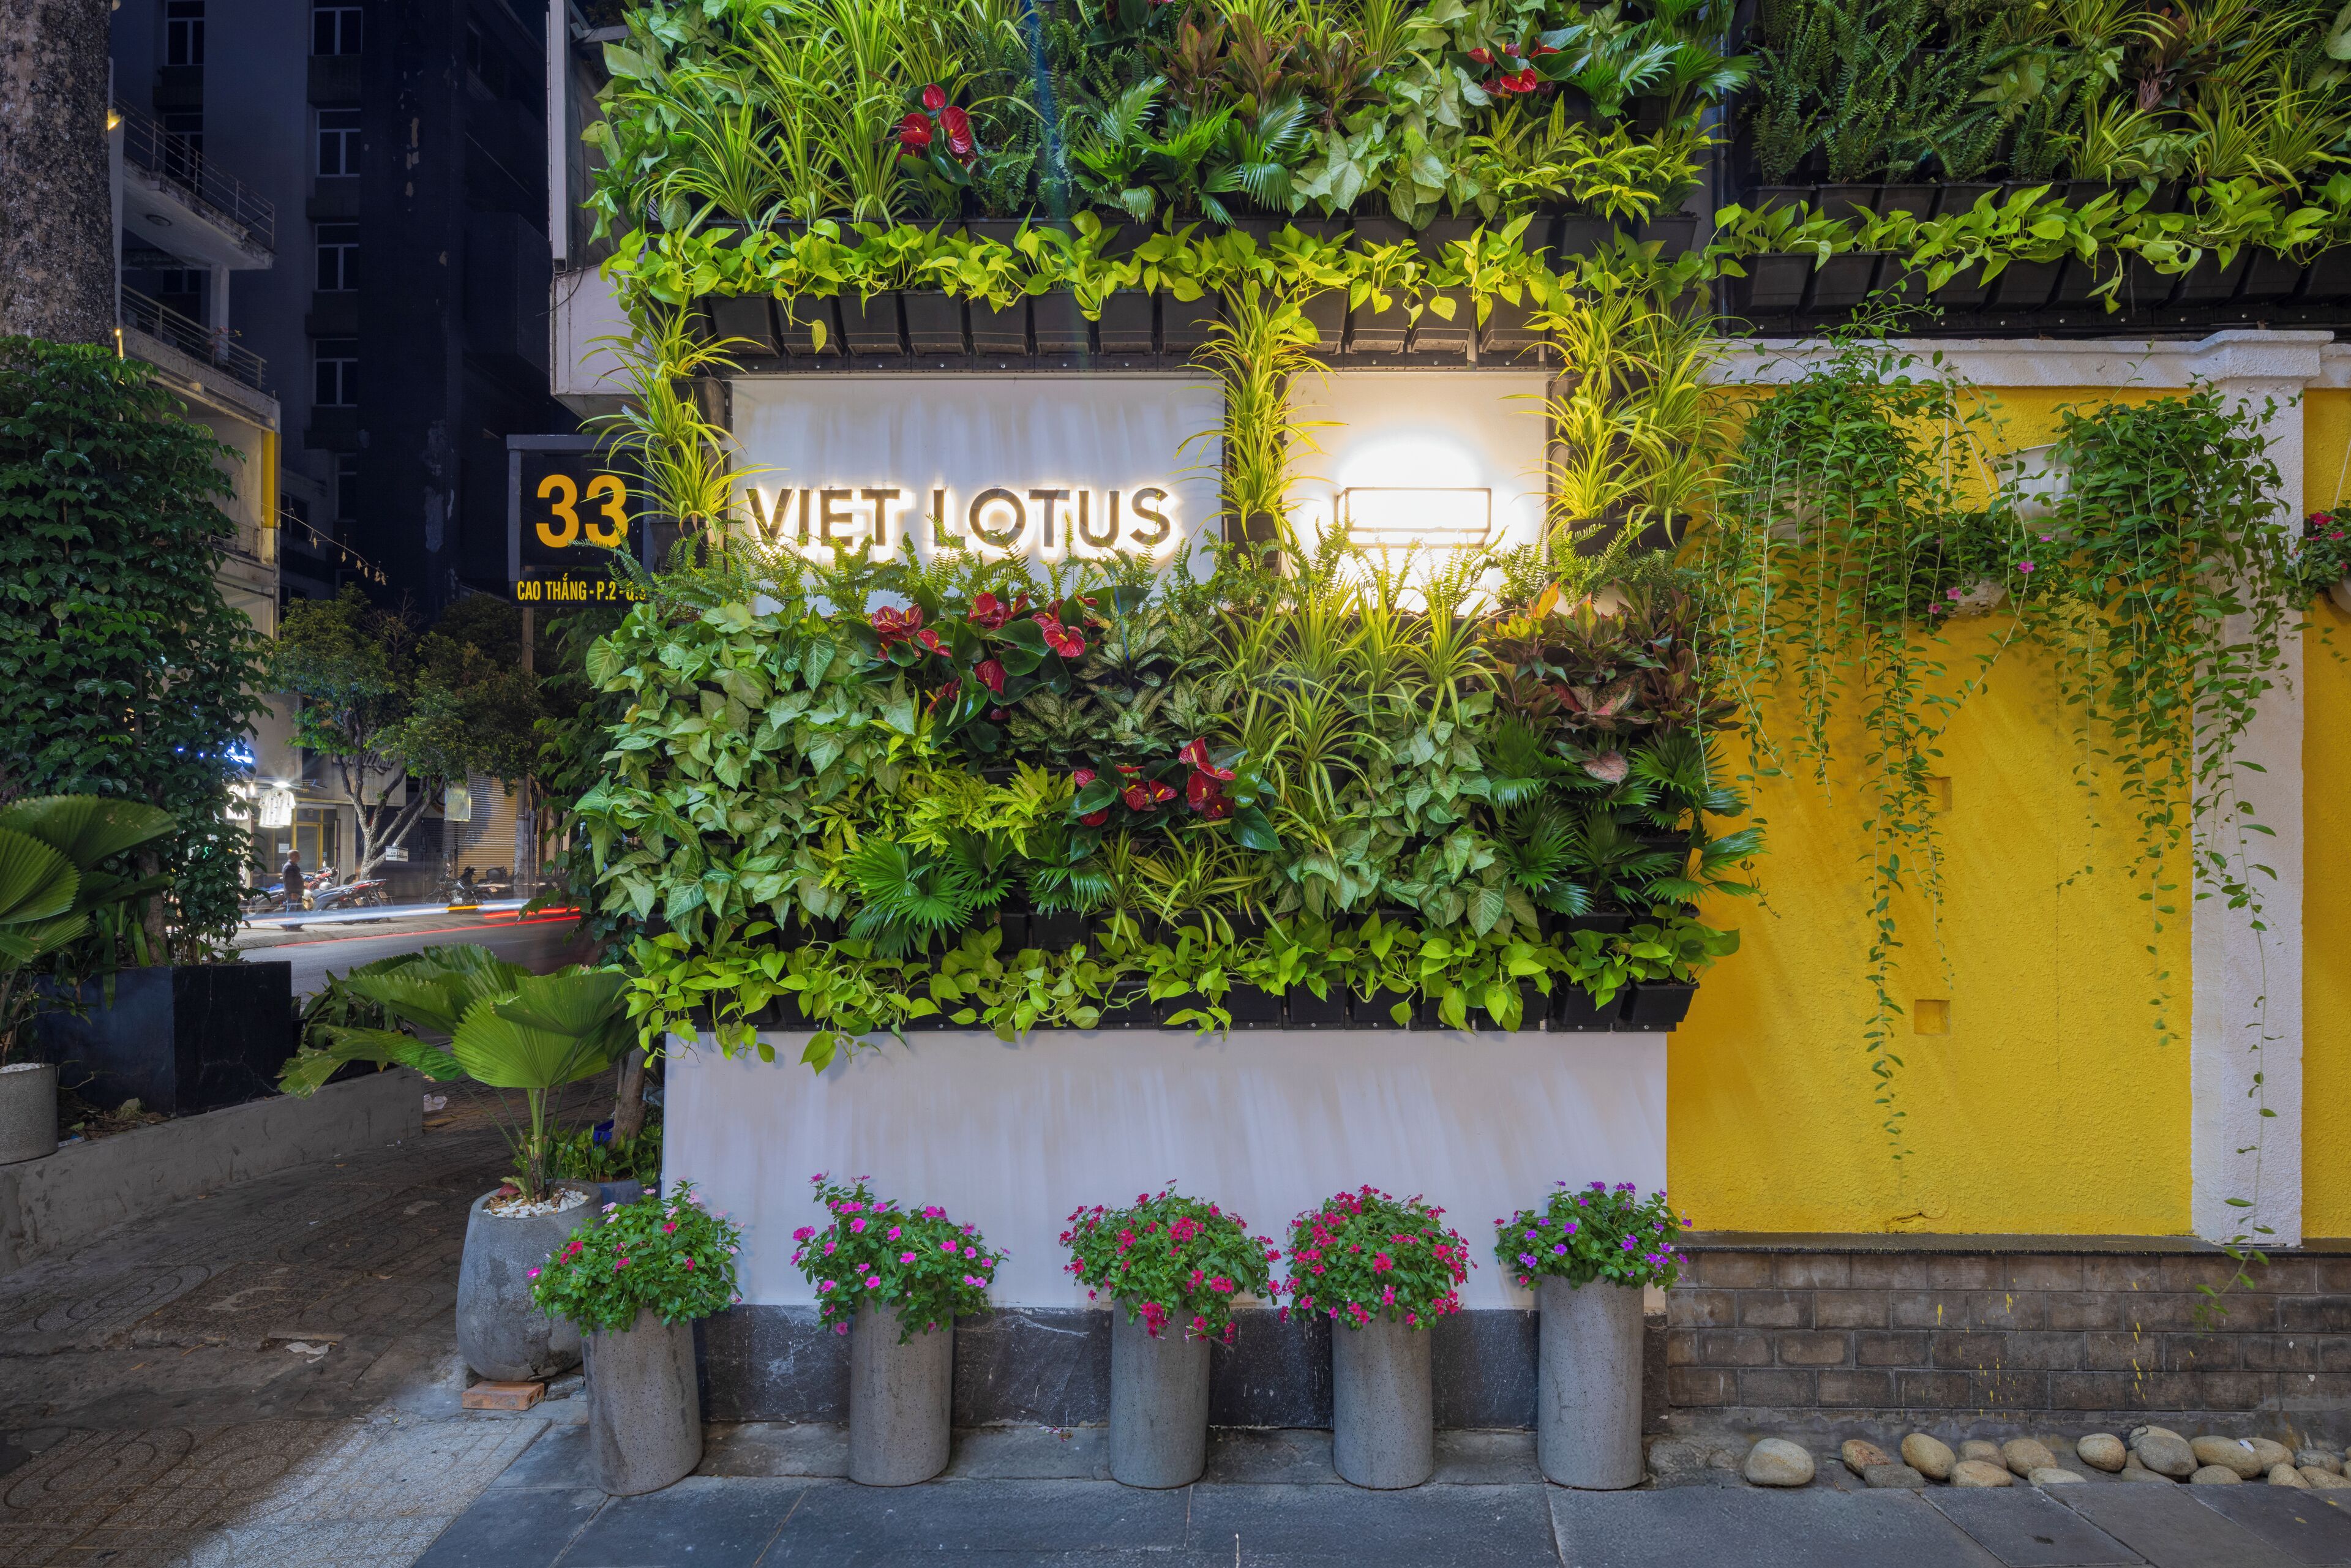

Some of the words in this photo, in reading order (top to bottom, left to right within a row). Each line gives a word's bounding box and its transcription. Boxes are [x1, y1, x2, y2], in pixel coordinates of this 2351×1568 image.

[536, 474, 628, 548] 33
[746, 488, 901, 547] VIET
[933, 487, 1171, 548] LOTUS
[517, 580, 541, 601] CAO
[545, 572, 587, 601] THẮNG
[596, 581, 617, 601] P.2
